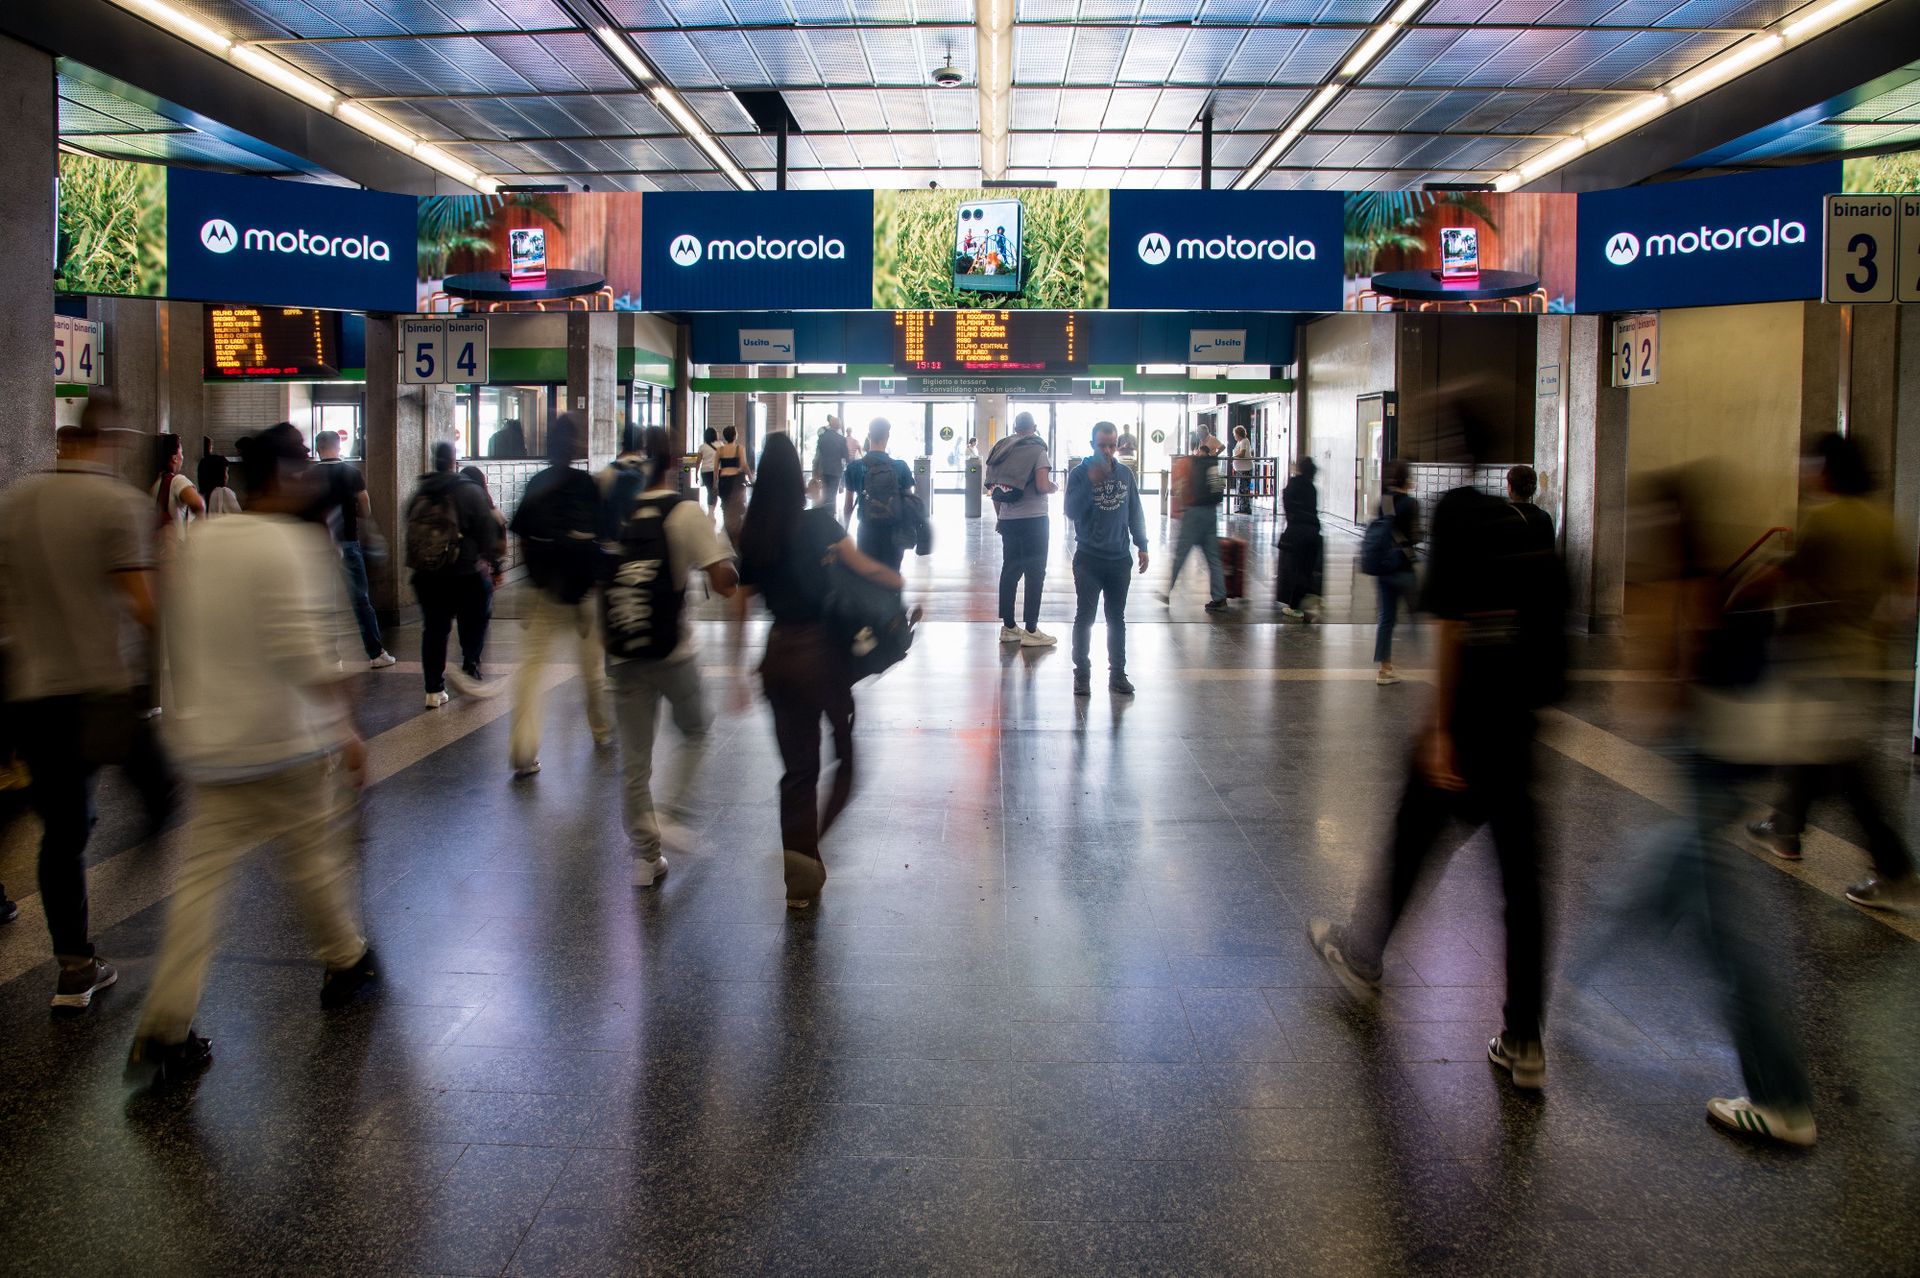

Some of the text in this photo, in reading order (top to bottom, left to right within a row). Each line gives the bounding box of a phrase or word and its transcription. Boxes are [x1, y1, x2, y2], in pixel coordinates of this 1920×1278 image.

[1834, 202, 1892, 216] binario
[244, 229, 391, 261] motorola
[708, 235, 845, 260] motorola
[1177, 235, 1316, 260] motorola
[1646, 219, 1806, 257] motorola
[1845, 233, 1878, 293] 3
[54, 320, 97, 334] ario binario
[407, 323, 484, 333] binario binario
[744, 338, 770, 346] Uscita
[1215, 338, 1241, 346] Uscita
[80, 343, 93, 377] 4
[415, 342, 477, 378] 5 4
[1621, 338, 1651, 380] 3 2
[922, 378, 953, 386] Biglietto
